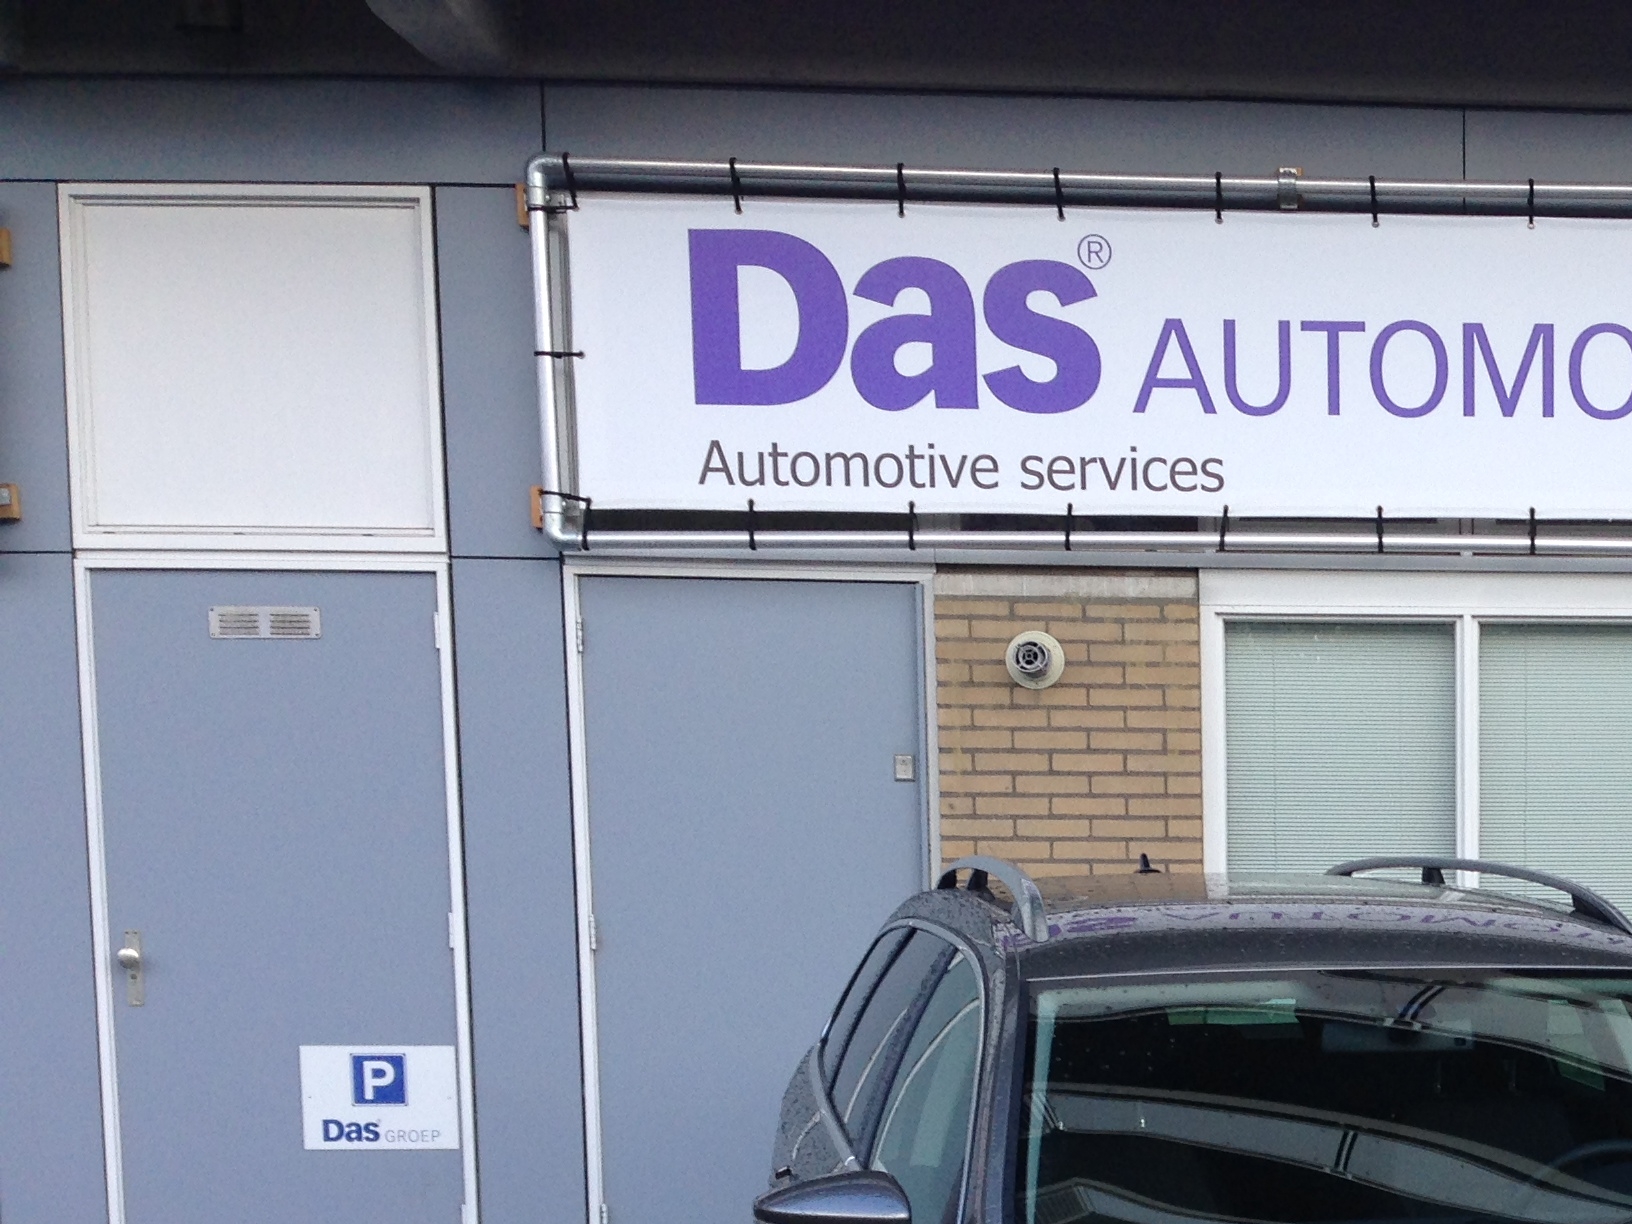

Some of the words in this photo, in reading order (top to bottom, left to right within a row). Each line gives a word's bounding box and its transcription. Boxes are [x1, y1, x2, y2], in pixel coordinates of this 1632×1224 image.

[698, 439, 1000, 491] Automotive
[1020, 446, 1225, 493] services
[362, 1060, 395, 1100] P
[384, 1129, 441, 1143] GROEP
